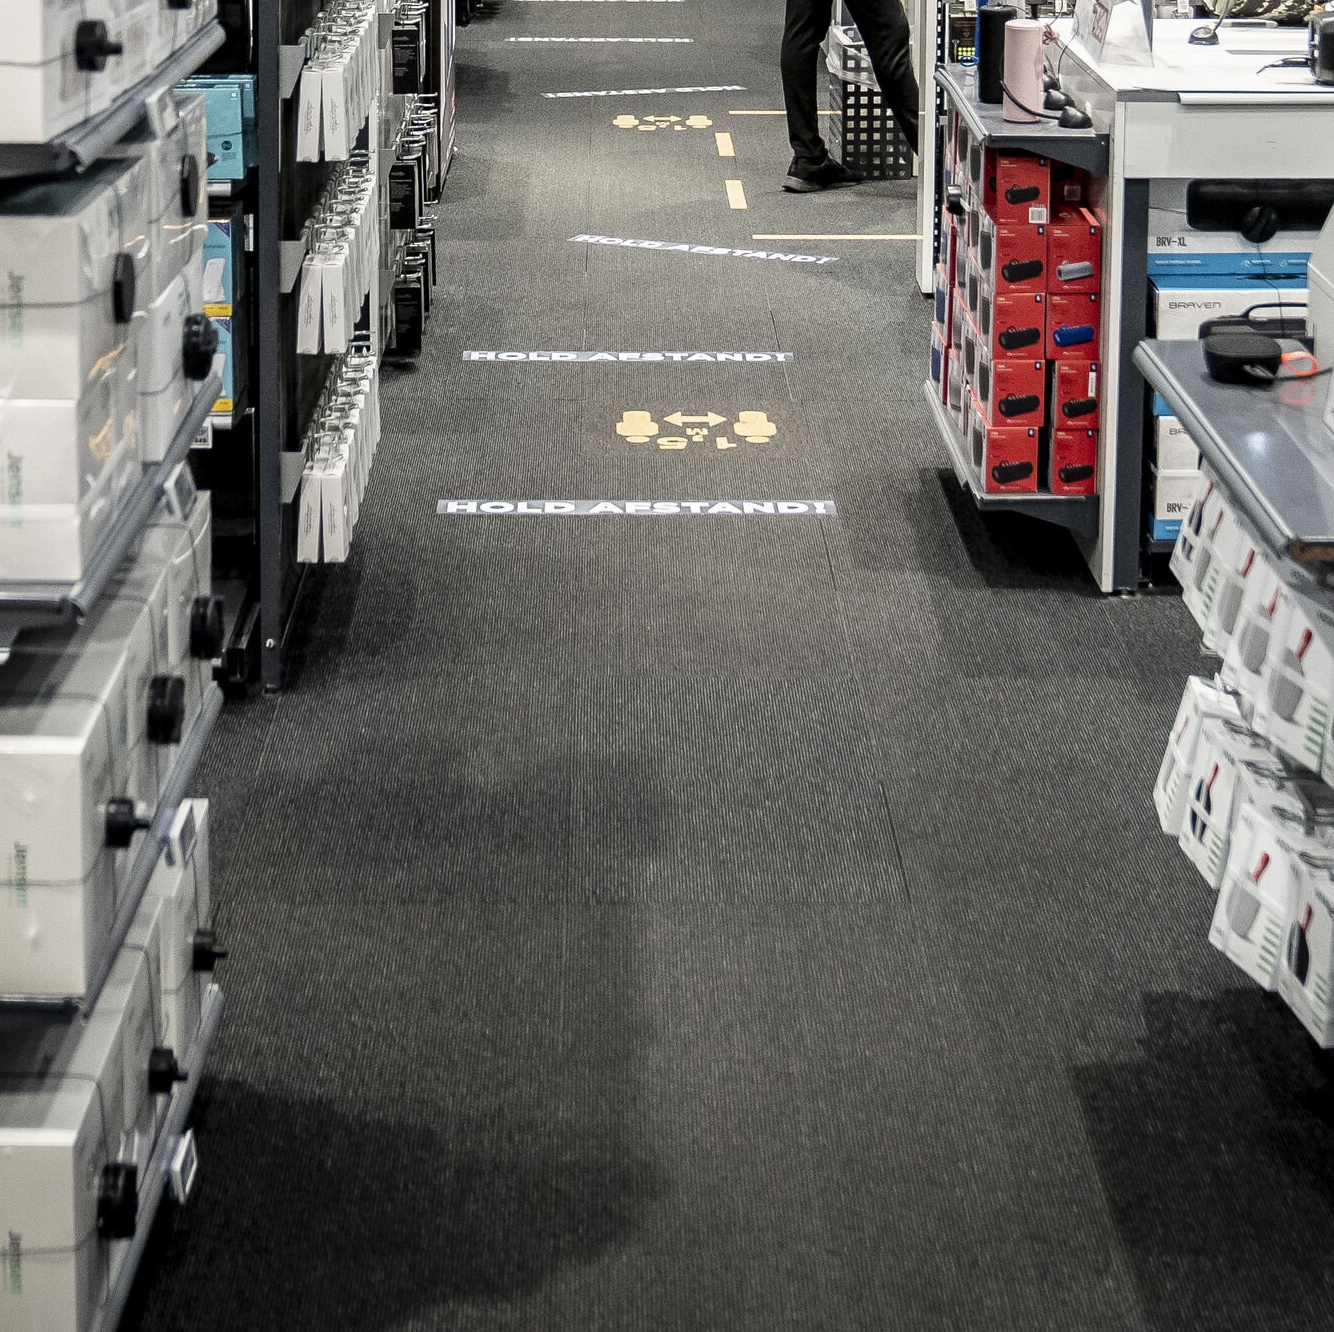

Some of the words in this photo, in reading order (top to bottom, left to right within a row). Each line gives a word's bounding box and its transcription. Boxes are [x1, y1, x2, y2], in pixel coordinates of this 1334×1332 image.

[1156, 236, 1188, 247] BRV-XL
[576, 234, 663, 250] HOLD
[664, 242, 835, 265] AFSTAND!
[1168, 301, 1221, 309] BRAVEN
[470, 351, 578, 362] HOLD
[591, 351, 786, 363] AFSTAND!
[445, 500, 576, 515] HOLD
[588, 500, 827, 515] AFSTAND!
